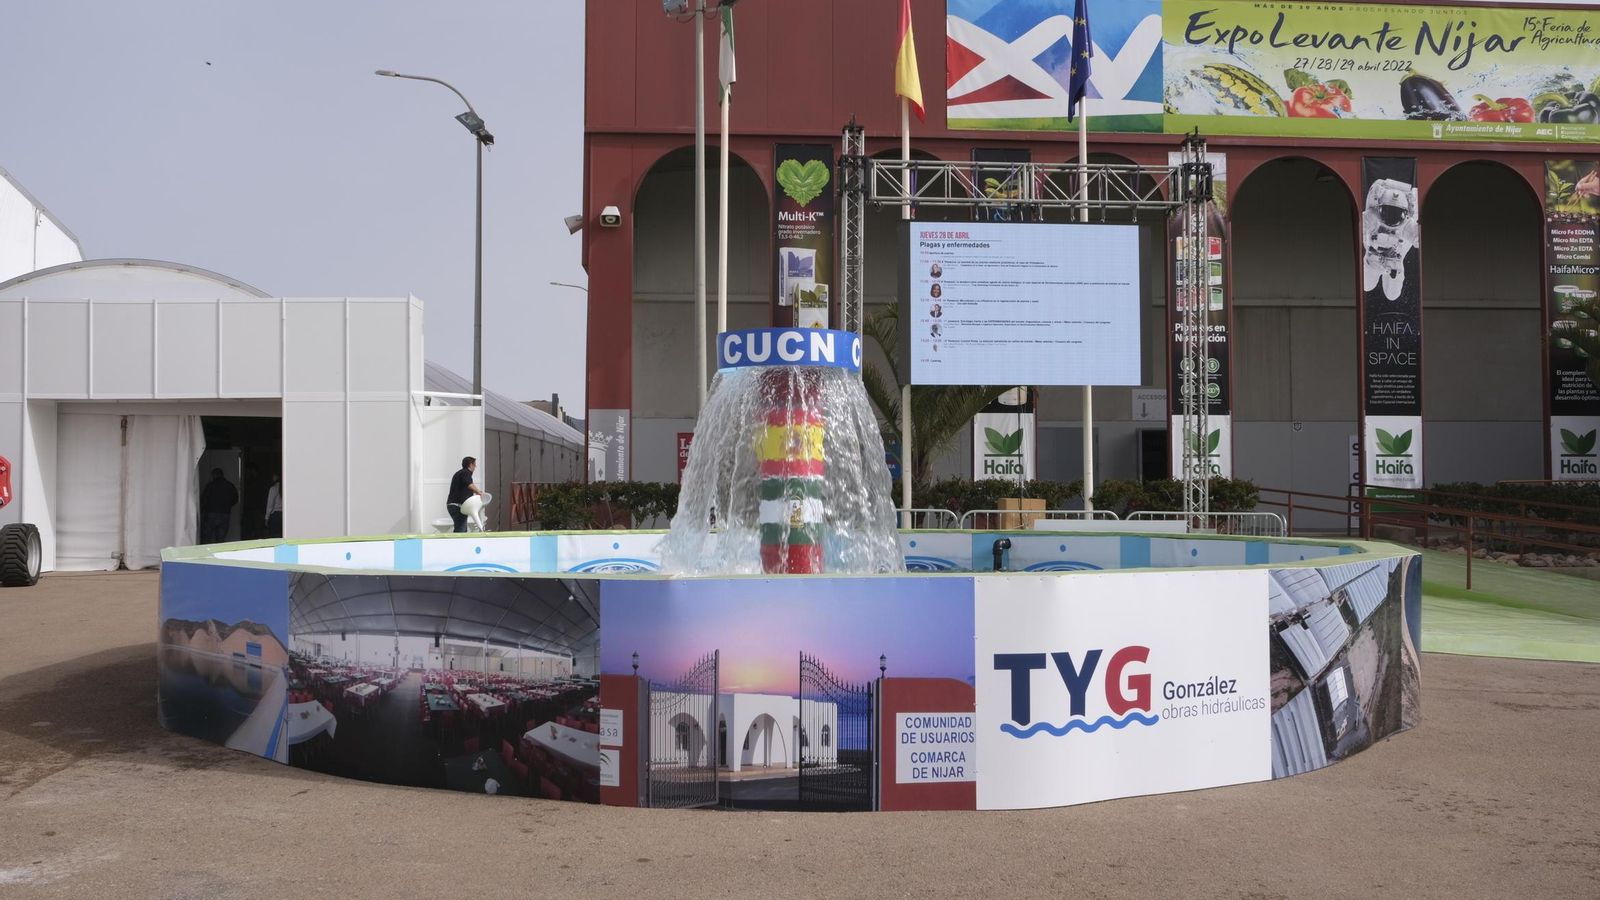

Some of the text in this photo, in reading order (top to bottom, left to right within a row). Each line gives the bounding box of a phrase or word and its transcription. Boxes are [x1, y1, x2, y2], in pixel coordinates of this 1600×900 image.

[1542, 16, 1573, 32] Feria
[1577, 20, 1591, 33] de
[1415, 21, 1525, 70] Níjar
[1293, 57, 1413, 72] 27/28/29 abril 2022
[1446, 124, 1493, 133] Ayuntamiento
[920, 241, 940, 249] Plagas
[947, 241, 990, 249] enfermedades
[1214, 324, 1226, 332] en
[1373, 322, 1413, 334] HAIFA
[723, 331, 835, 364] CUCN
[1386, 338, 1399, 350] IN
[1369, 352, 1417, 365] SPACE
[984, 459, 1023, 474] Haifa
[1376, 459, 1413, 474] Haifa
[1560, 459, 1597, 474] Haifa
[993, 645, 1152, 726] TYG
[1162, 676, 1238, 701] González
[1162, 694, 1266, 720] obras hidráulicas
[905, 716, 972, 729] COMUNIDAD
[901, 731, 975, 744] DE USUARIOS
[910, 751, 967, 764] COMARCA
[912, 766, 965, 779] DE NIJAR
